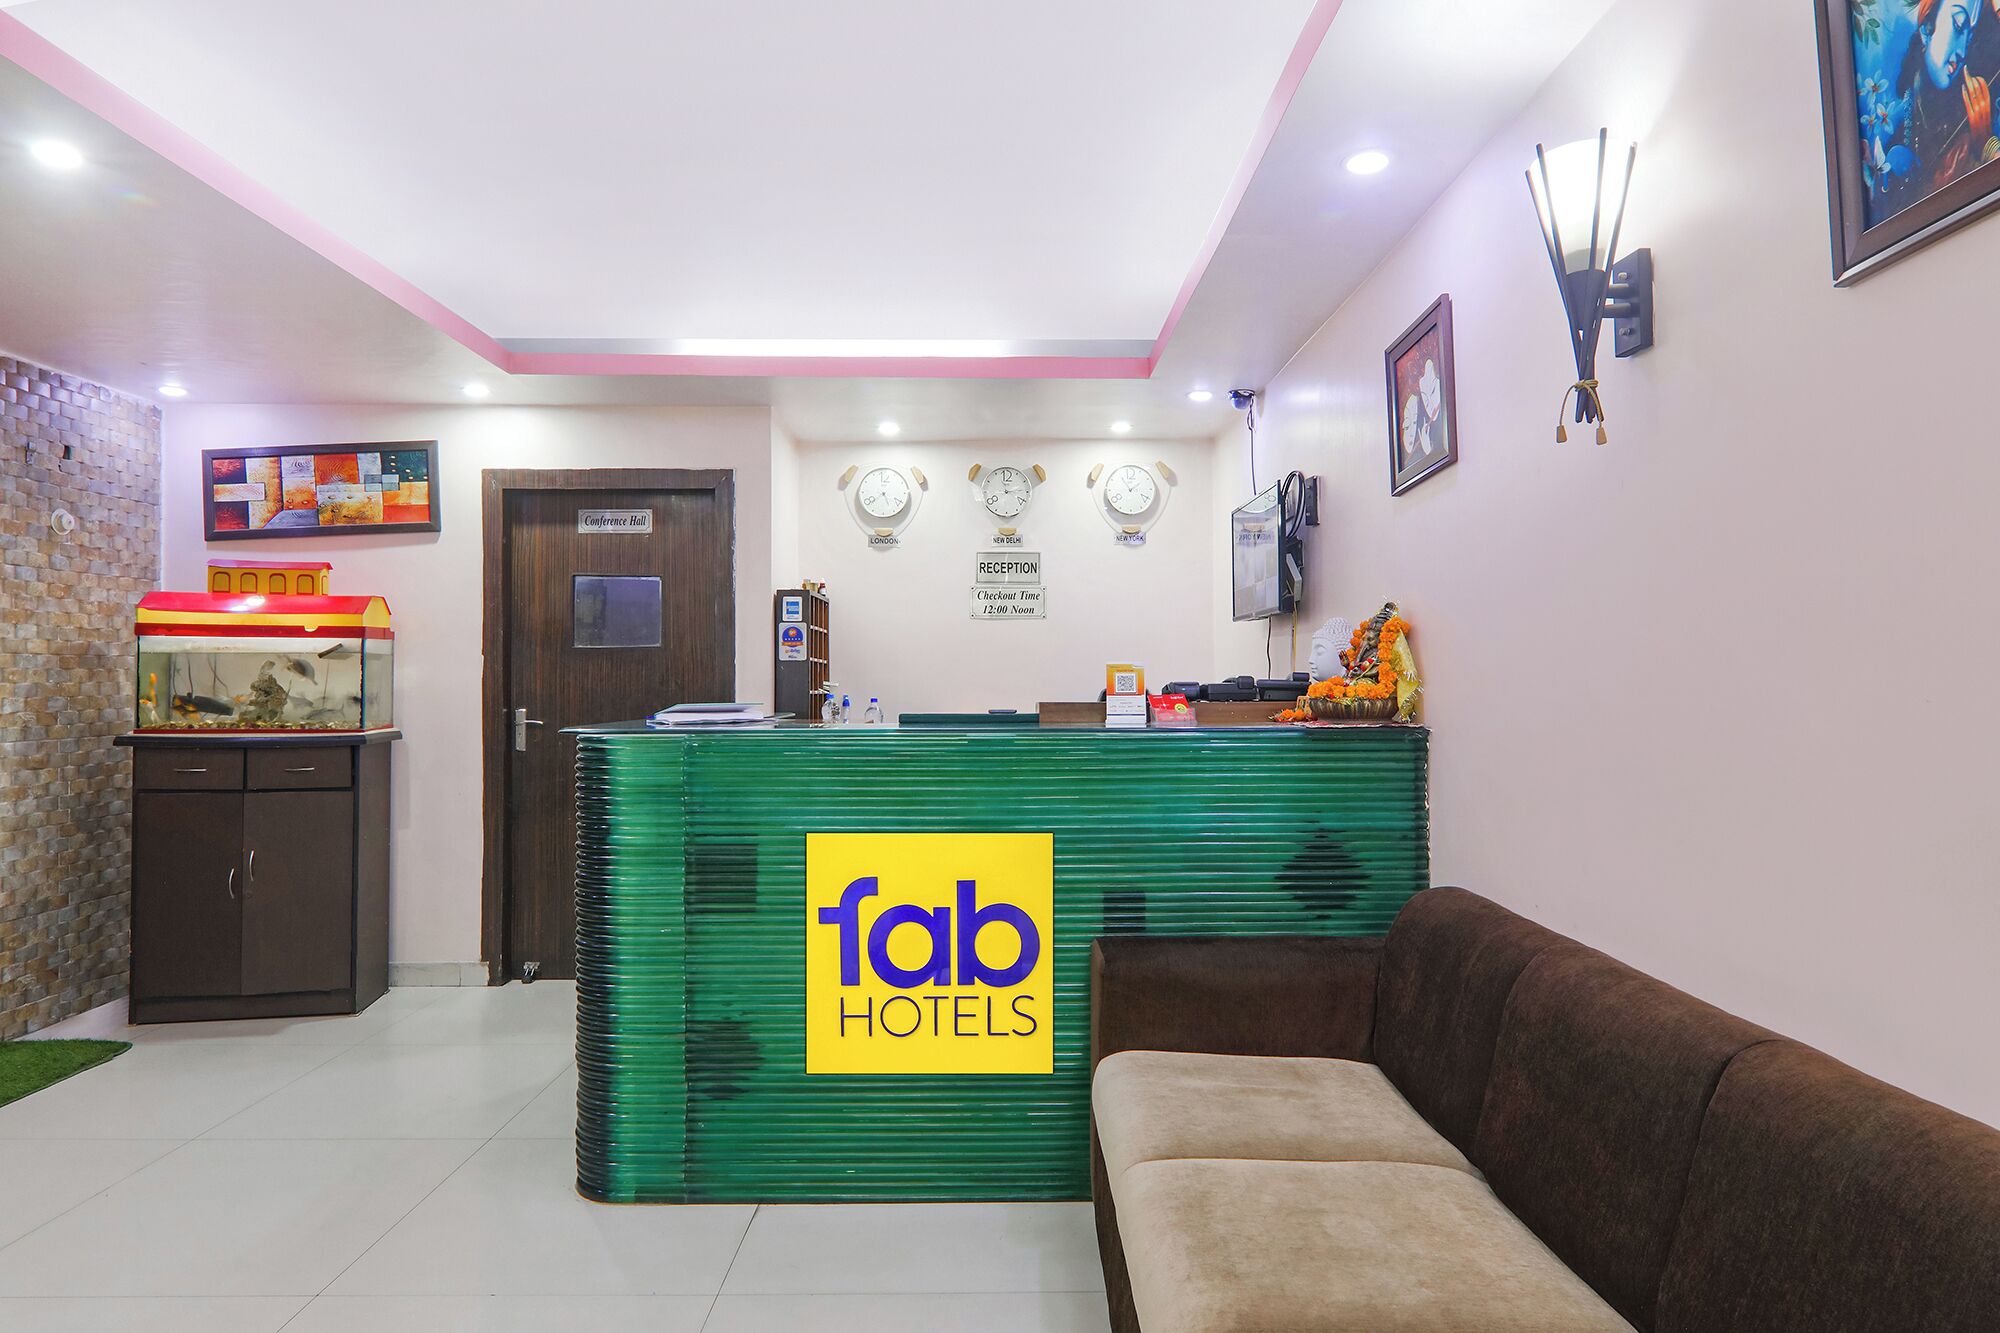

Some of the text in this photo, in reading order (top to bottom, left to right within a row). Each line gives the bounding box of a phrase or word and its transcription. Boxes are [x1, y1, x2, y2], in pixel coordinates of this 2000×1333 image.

[1001, 470, 1013, 482] 12
[1125, 468, 1136, 480] 12
[864, 496, 876, 506] 8
[894, 497, 904, 507] 4
[986, 495, 998, 505] 8
[1017, 496, 1027, 506] 4
[1111, 493, 1122, 503] 8
[1140, 493, 1151, 503] 4
[584, 515, 646, 528] Conference Hall
[870, 537, 899, 545] LONDON
[979, 562, 1038, 574] RECEPTION
[977, 590, 1041, 601] Checkout Time
[983, 604, 1035, 614] 12:00 Noon
[818, 876, 1041, 989] fab
[840, 995, 1038, 1038] HOTELS
